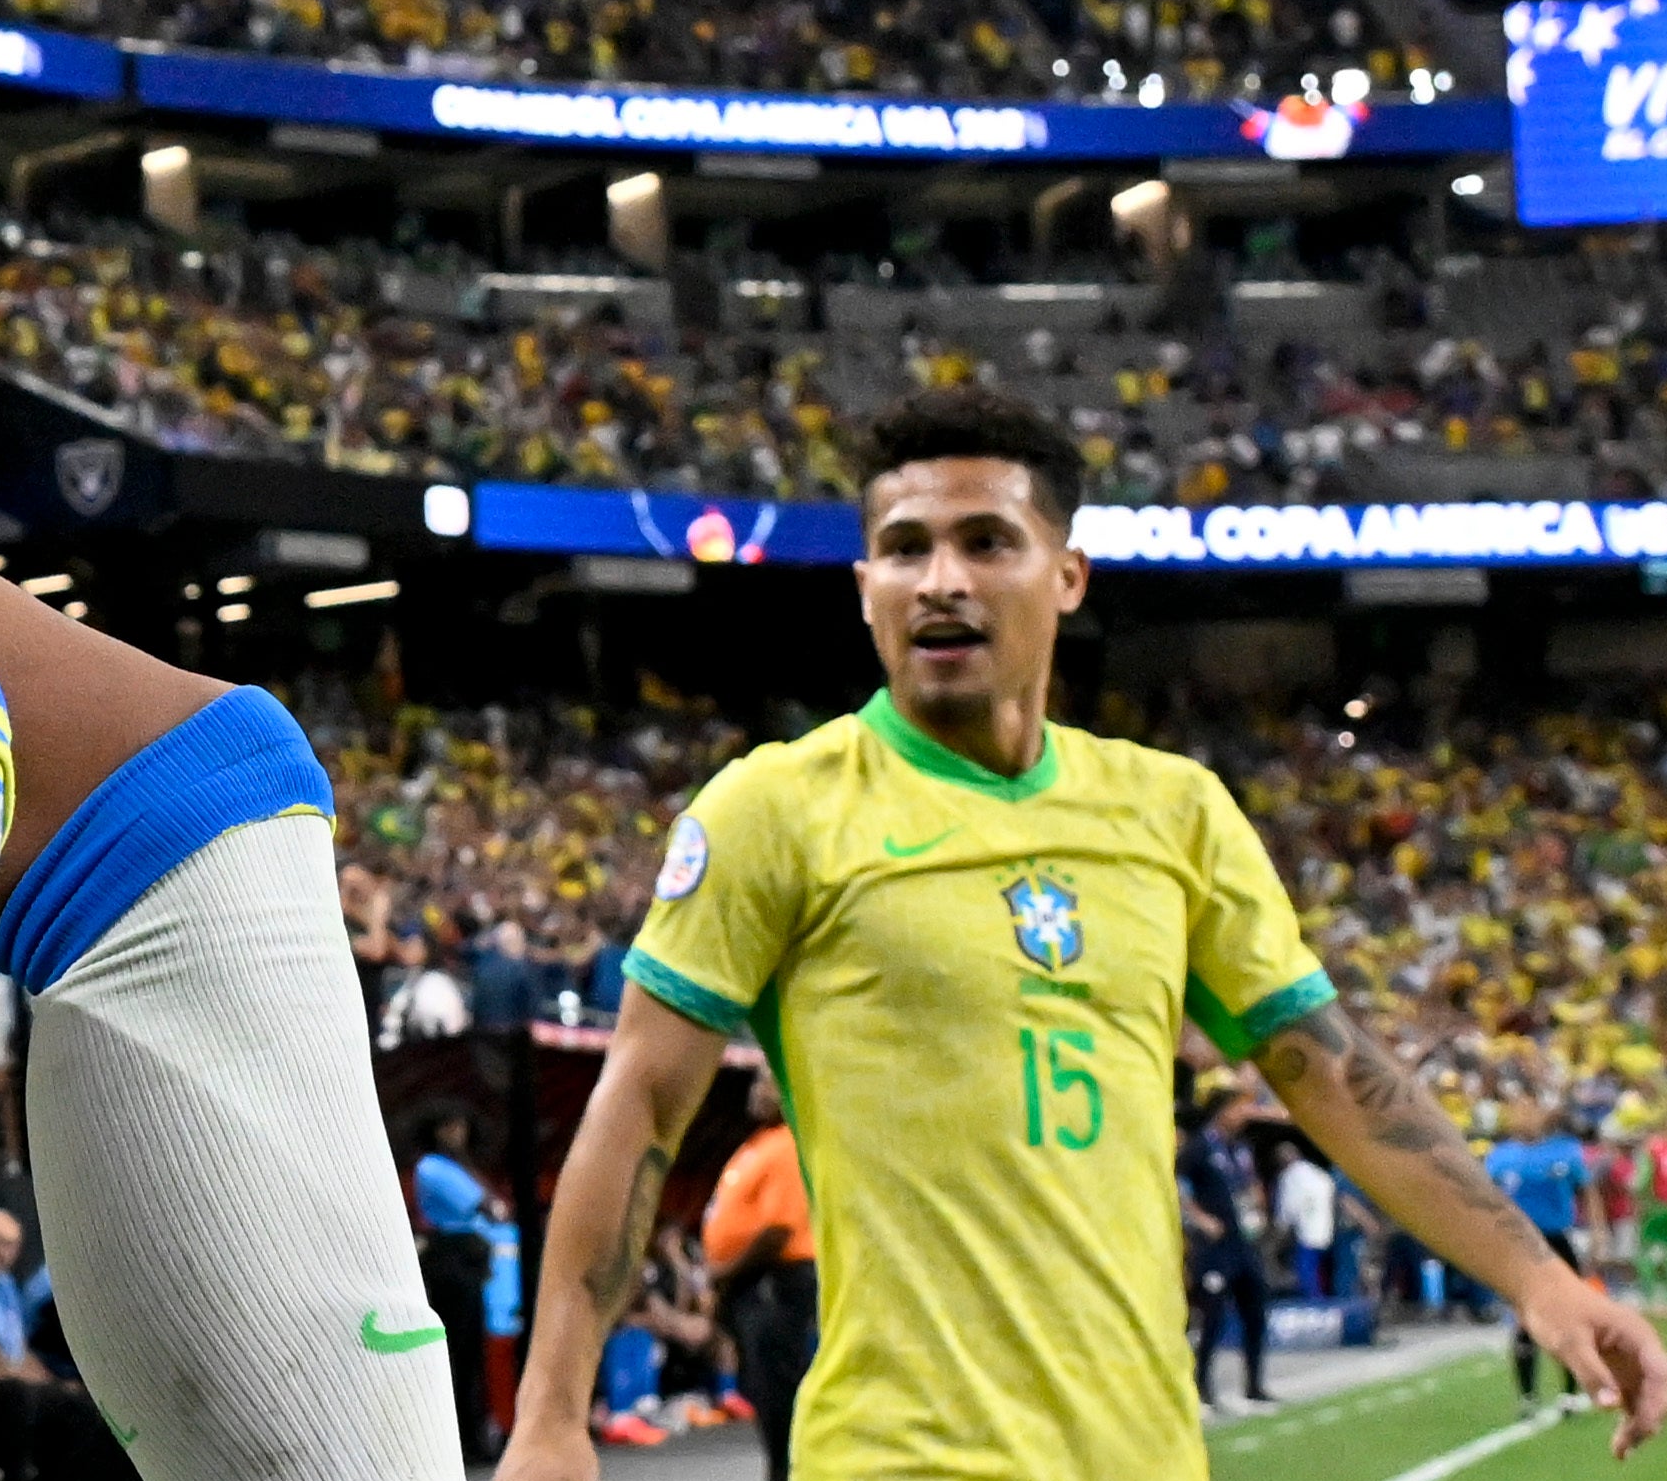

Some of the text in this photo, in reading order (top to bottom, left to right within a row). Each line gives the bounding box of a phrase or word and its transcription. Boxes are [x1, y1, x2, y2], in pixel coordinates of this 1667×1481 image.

[1202, 503, 1361, 561] COPA
[1356, 500, 1606, 559] AMERICA
[1019, 1027, 1105, 1152] 15
